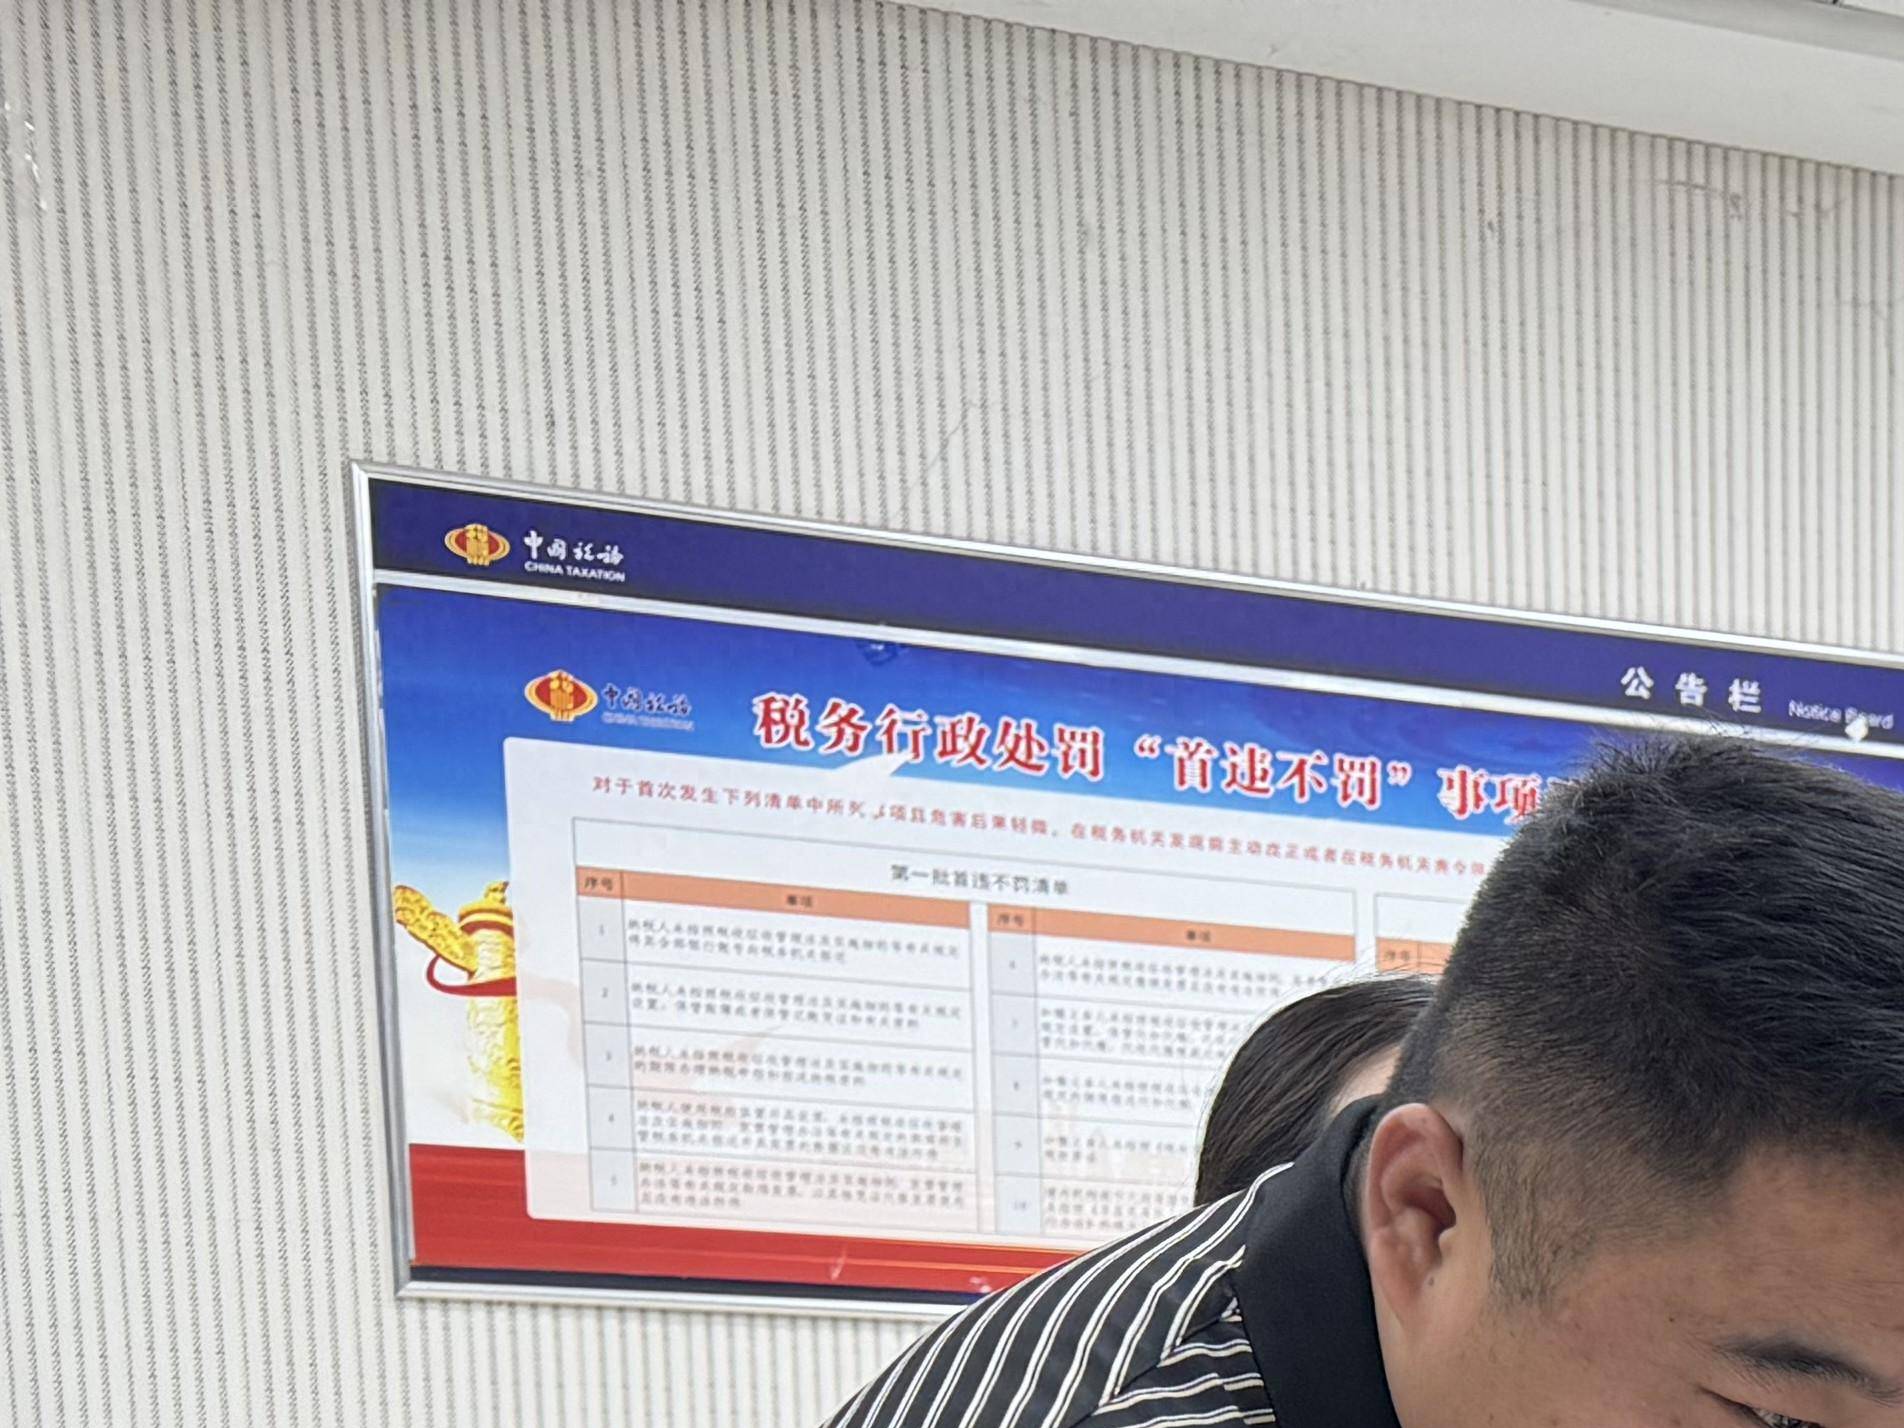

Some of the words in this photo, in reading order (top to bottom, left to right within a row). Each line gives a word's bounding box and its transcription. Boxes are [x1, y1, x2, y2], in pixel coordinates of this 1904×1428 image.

[524, 530, 624, 565] 中国税务
[524, 561, 564, 576] CHINA
[566, 564, 626, 583] TAXATION
[1620, 665, 1762, 714] 公告栏
[1788, 699, 1842, 724] Notice
[1845, 707, 1895, 731] Bard
